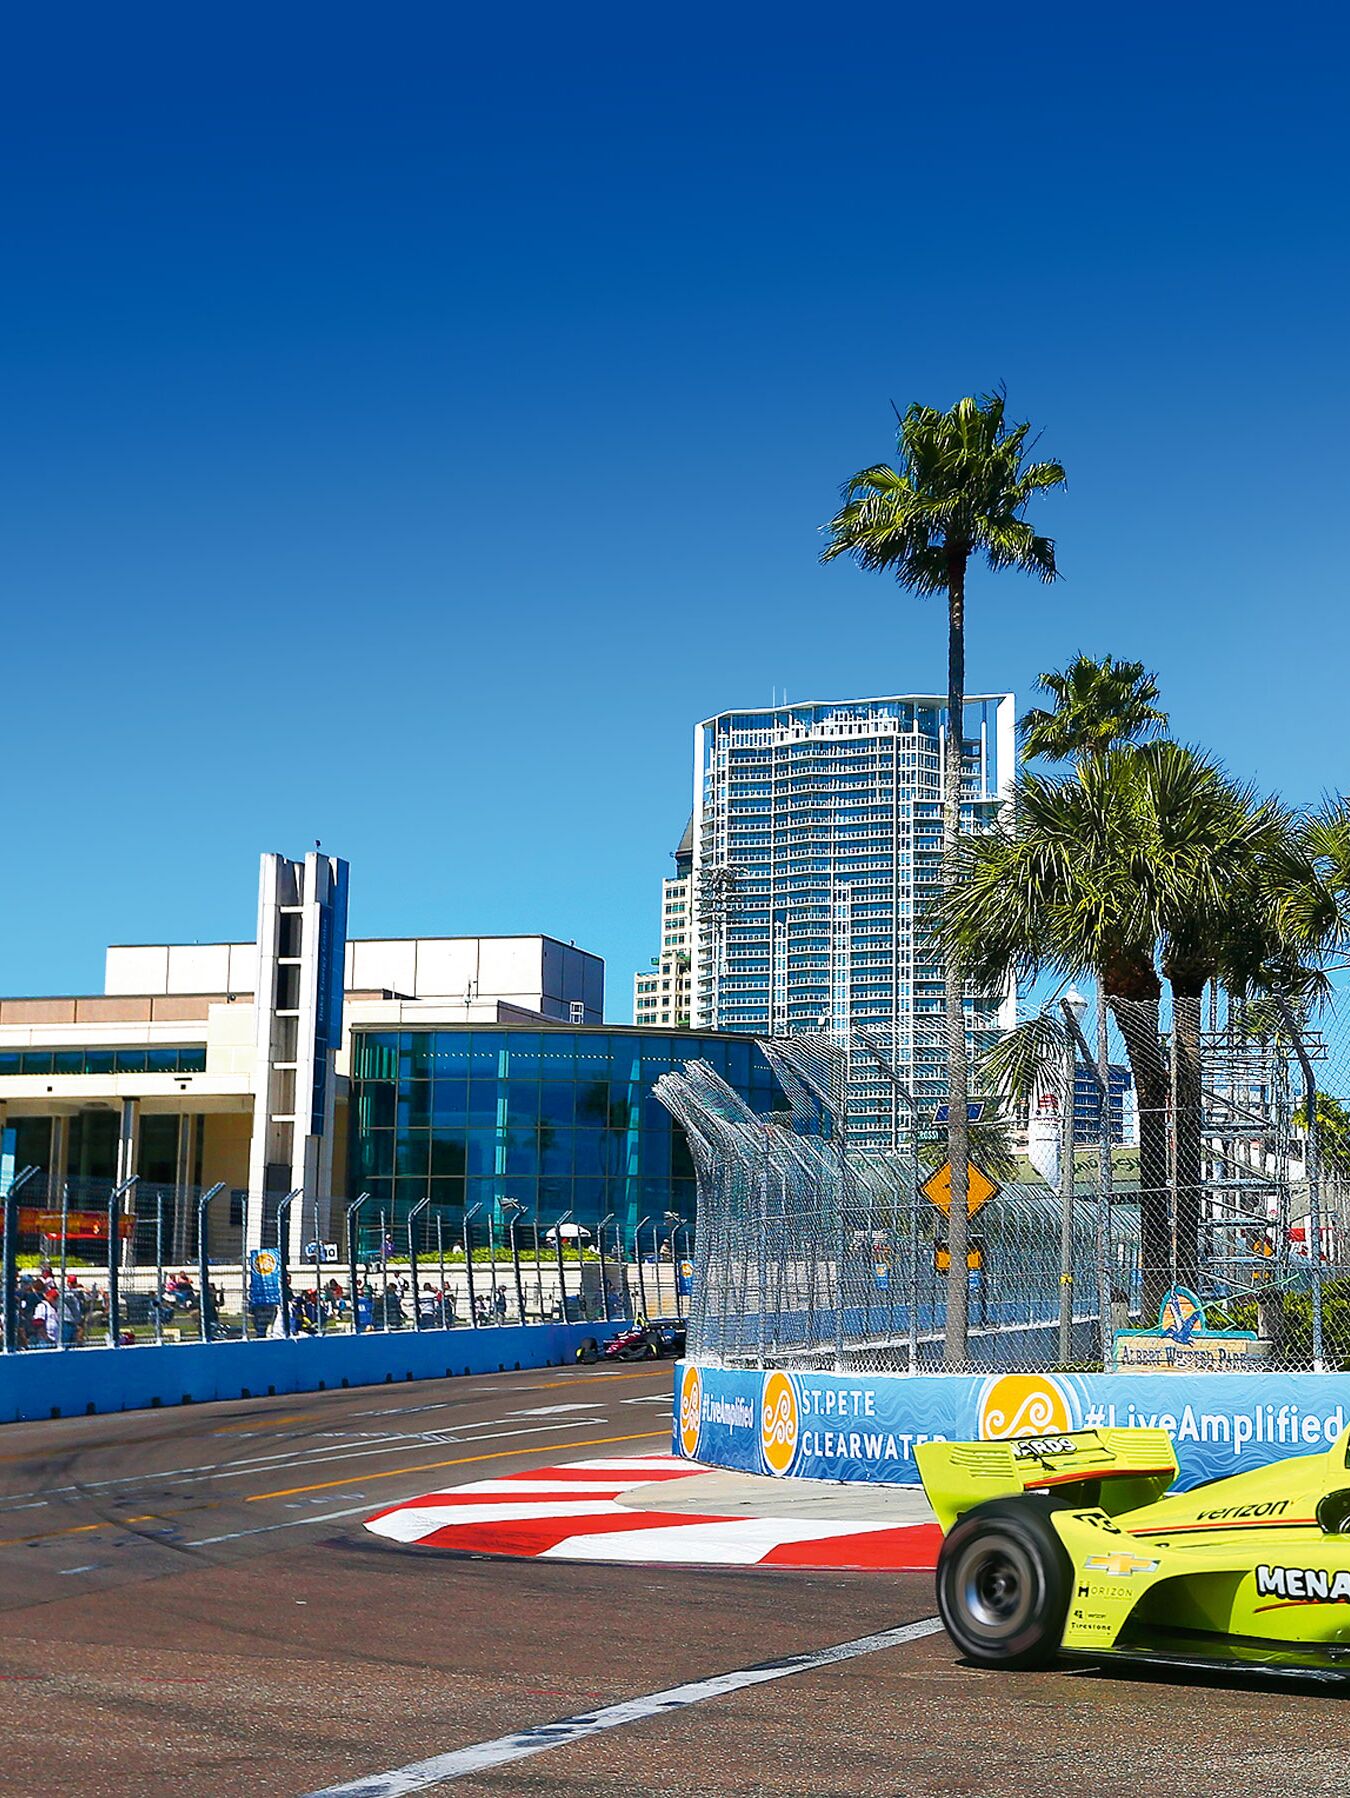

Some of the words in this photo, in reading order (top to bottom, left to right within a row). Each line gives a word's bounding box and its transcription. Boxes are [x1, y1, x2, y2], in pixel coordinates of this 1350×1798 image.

[801, 1389, 876, 1416] ST.PETE
[1196, 1499, 1290, 1521] verizon
[1078, 1585, 1133, 1598] HORIZON
